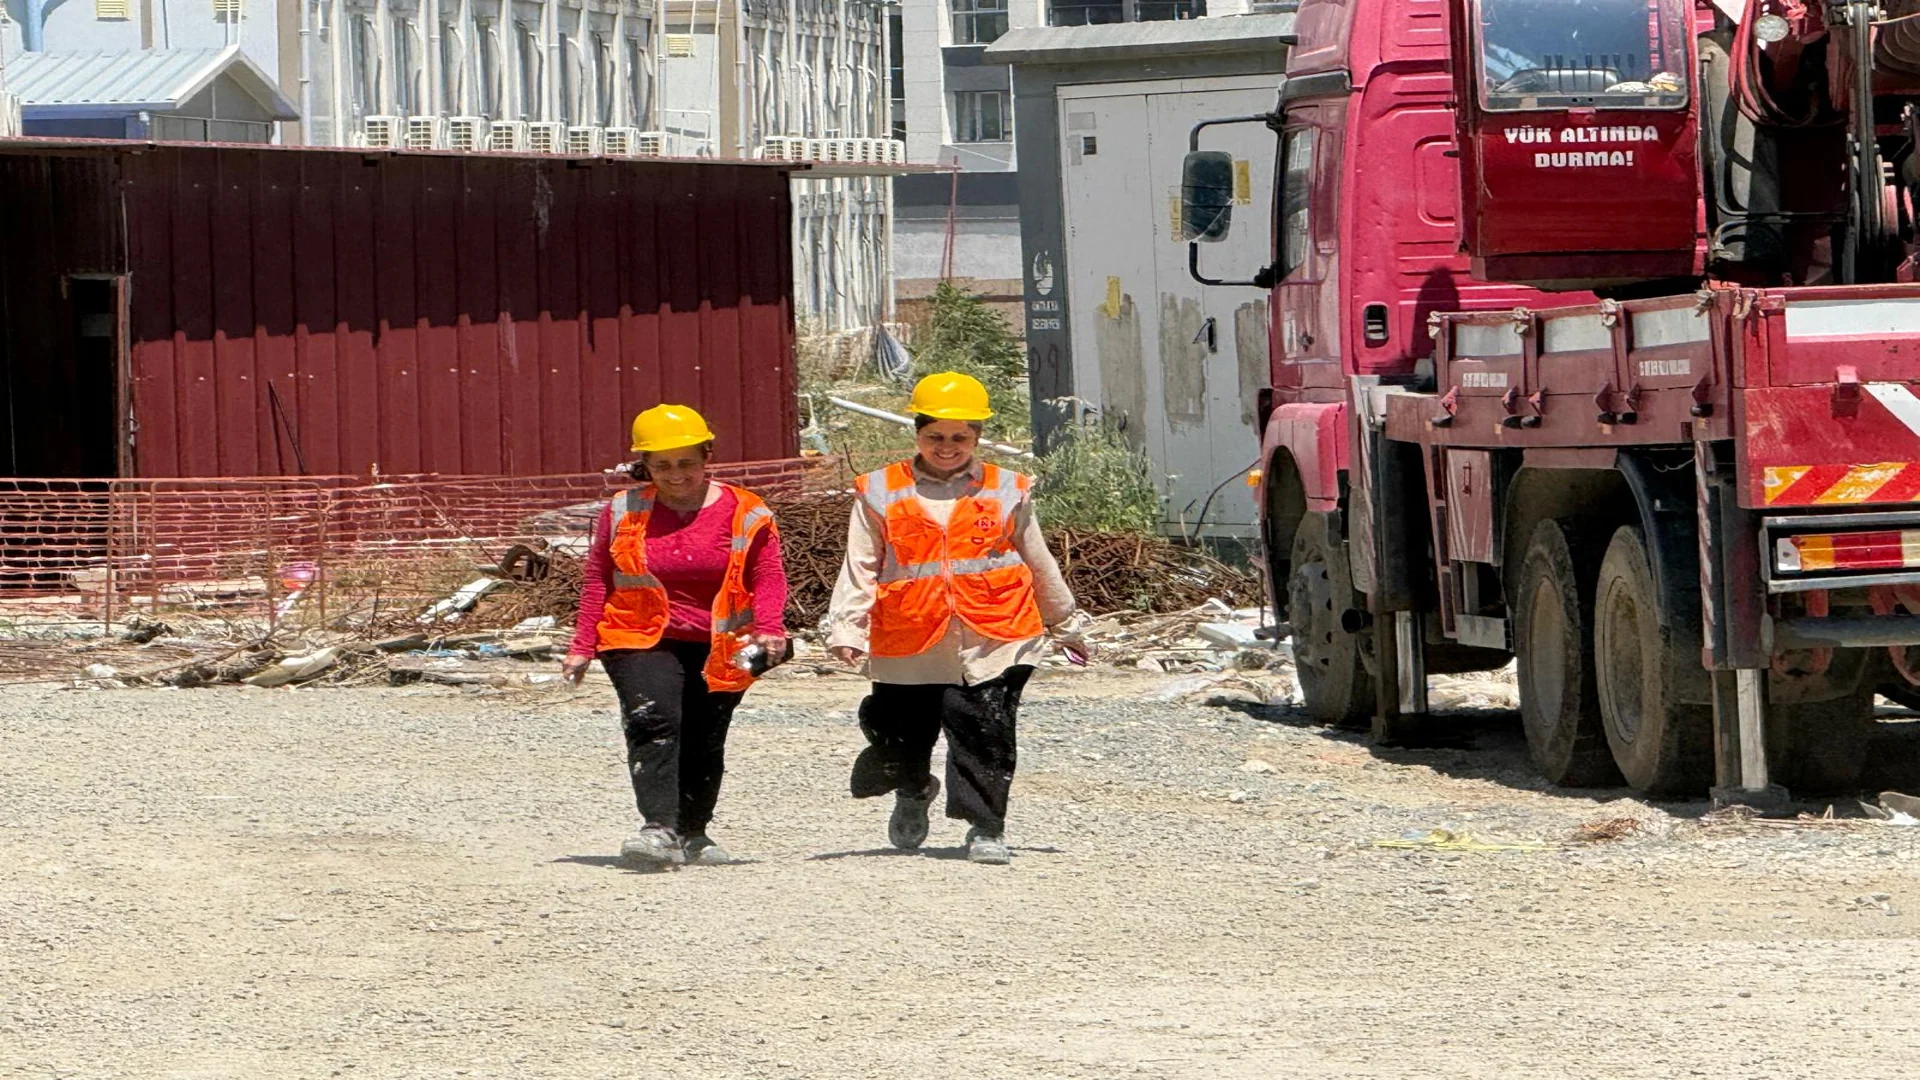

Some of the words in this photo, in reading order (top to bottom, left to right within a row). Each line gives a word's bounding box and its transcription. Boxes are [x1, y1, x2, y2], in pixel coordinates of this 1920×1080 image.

[1503, 125, 1552, 144] YÜK
[1560, 125, 1659, 143] ALTINDA
[1534, 151, 1634, 168] DURMA!
